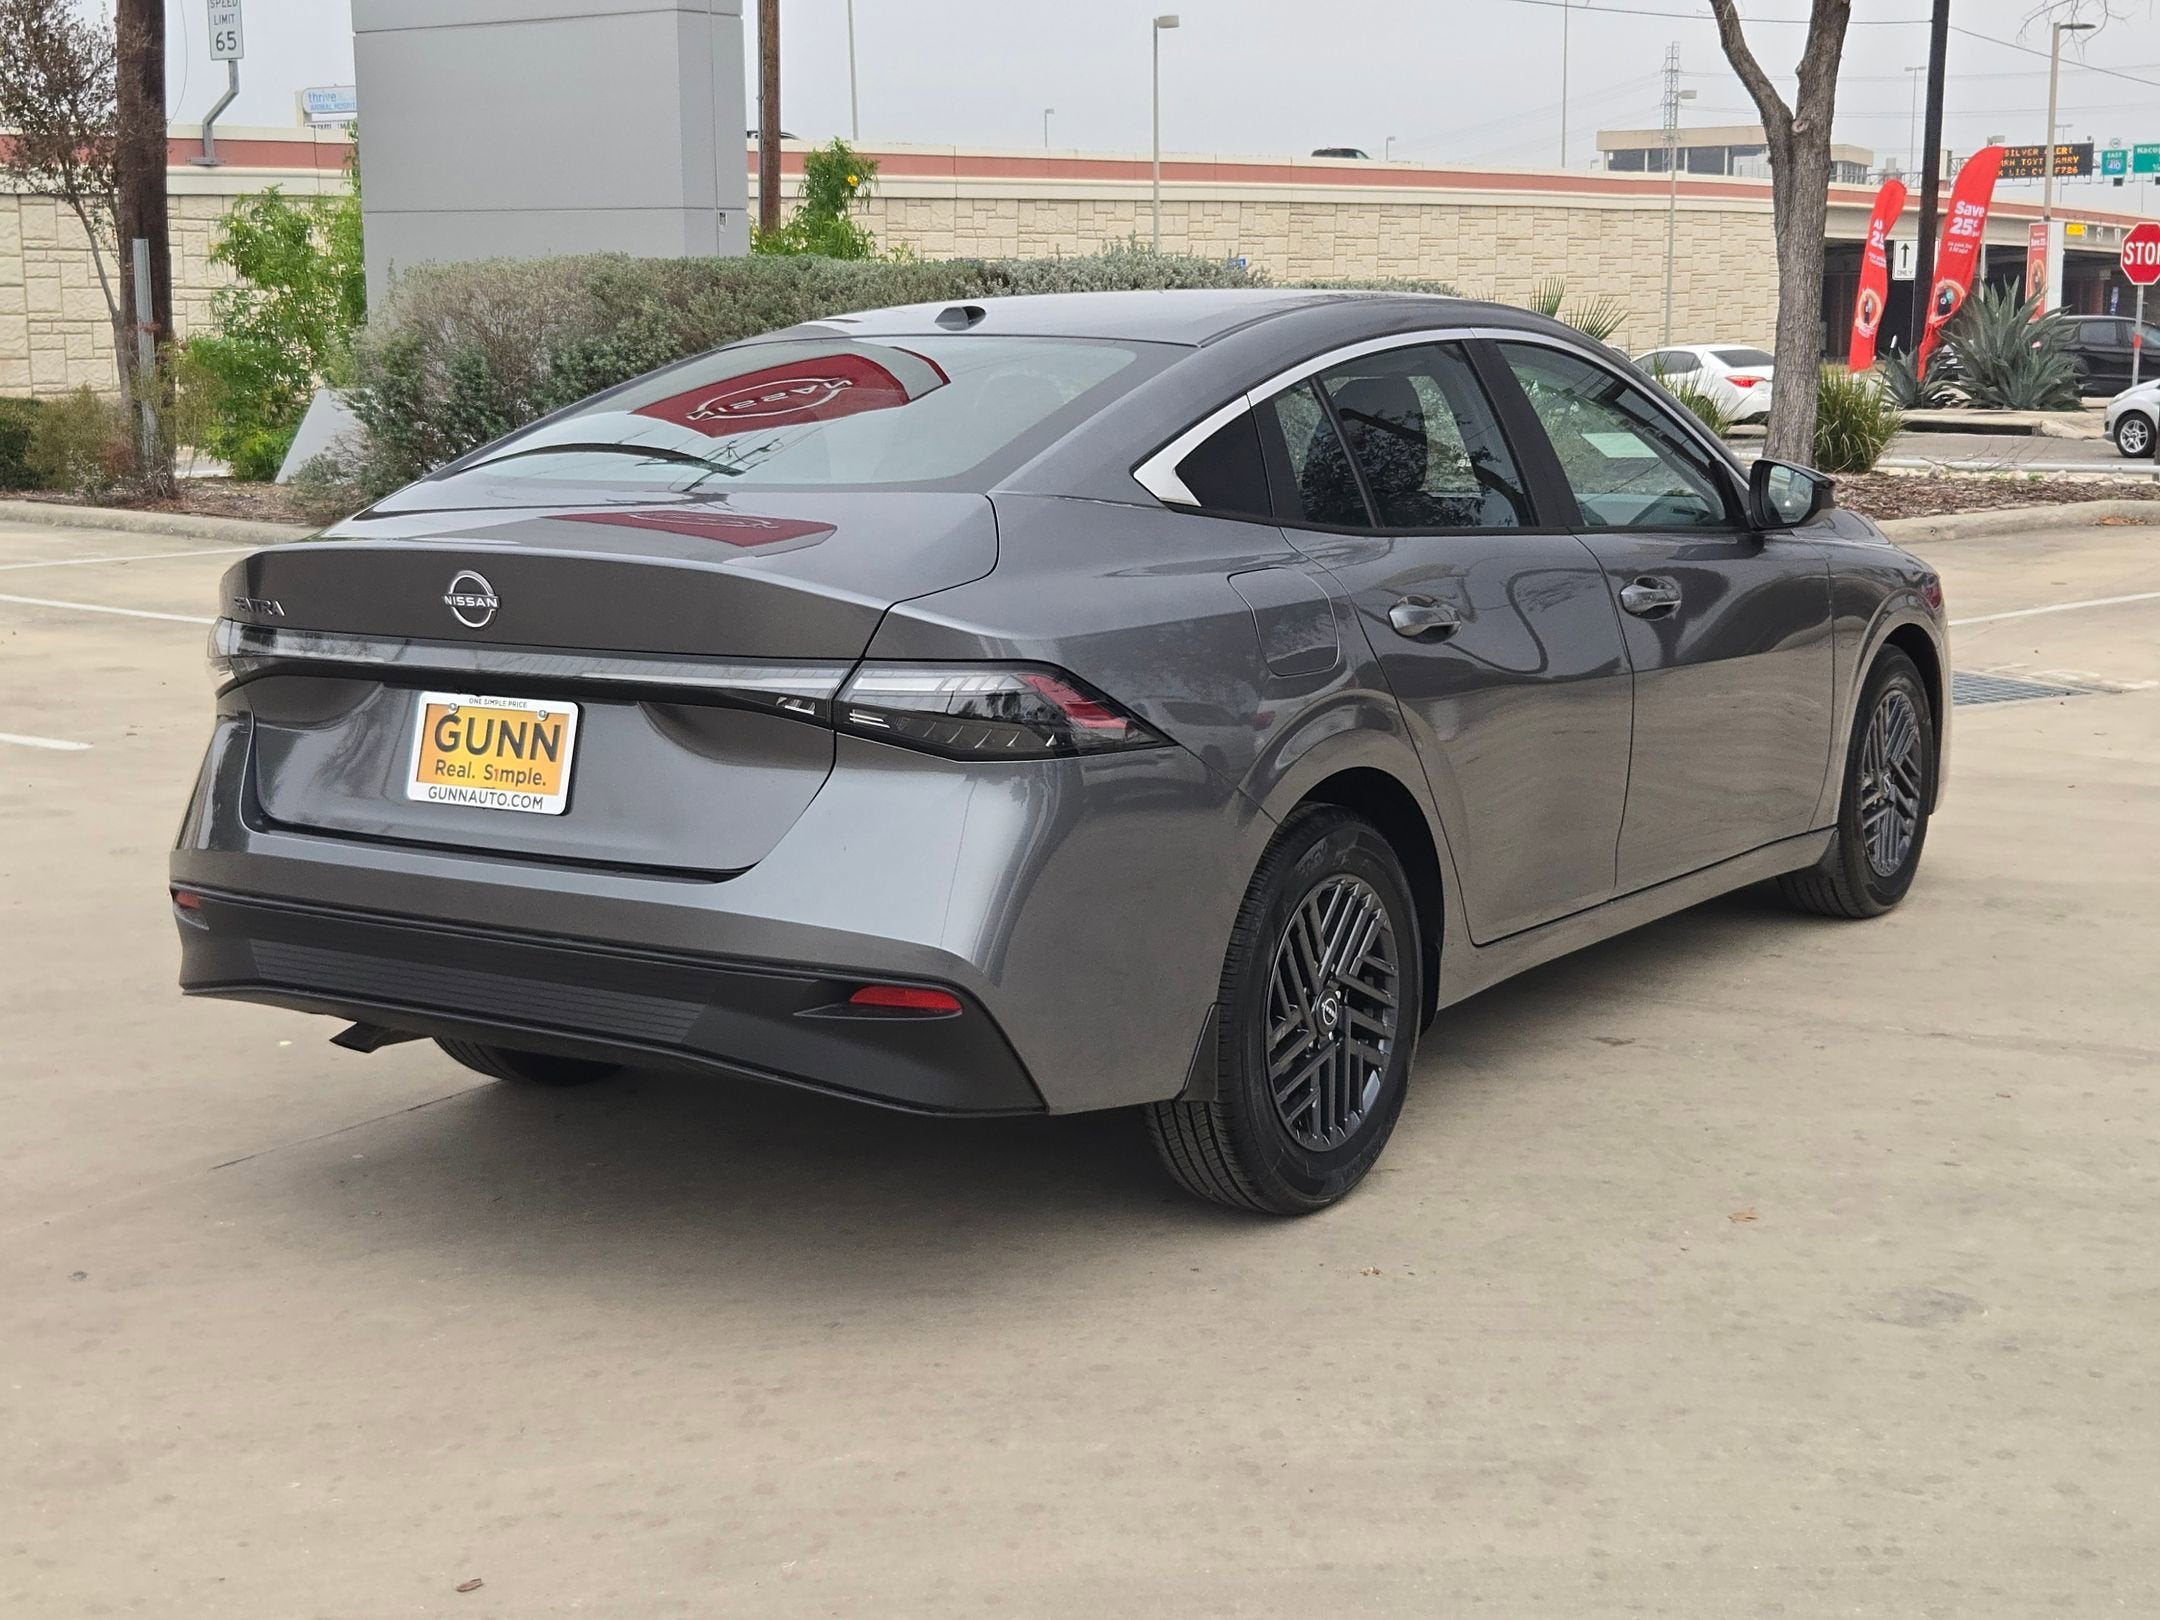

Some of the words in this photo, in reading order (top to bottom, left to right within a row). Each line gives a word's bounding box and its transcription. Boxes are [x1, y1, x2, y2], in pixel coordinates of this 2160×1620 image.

[210, 0, 238, 9] SPEED
[213, 14, 235, 25] LIMIT
[216, 31, 237, 51] 65
[308, 92, 337, 103] thrive
[2004, 148, 2039, 157] SILVER
[2054, 155, 2079, 164] AMRY
[1954, 200, 1985, 217] Save
[444, 595, 498, 608] NISSAN
[468, 697, 482, 705] ONE
[484, 699, 506, 707] SIMPLE
[434, 714, 561, 763] GUNN
[434, 759, 476, 779] Real.
[428, 786, 544, 810] GUNNAUTO.COM
